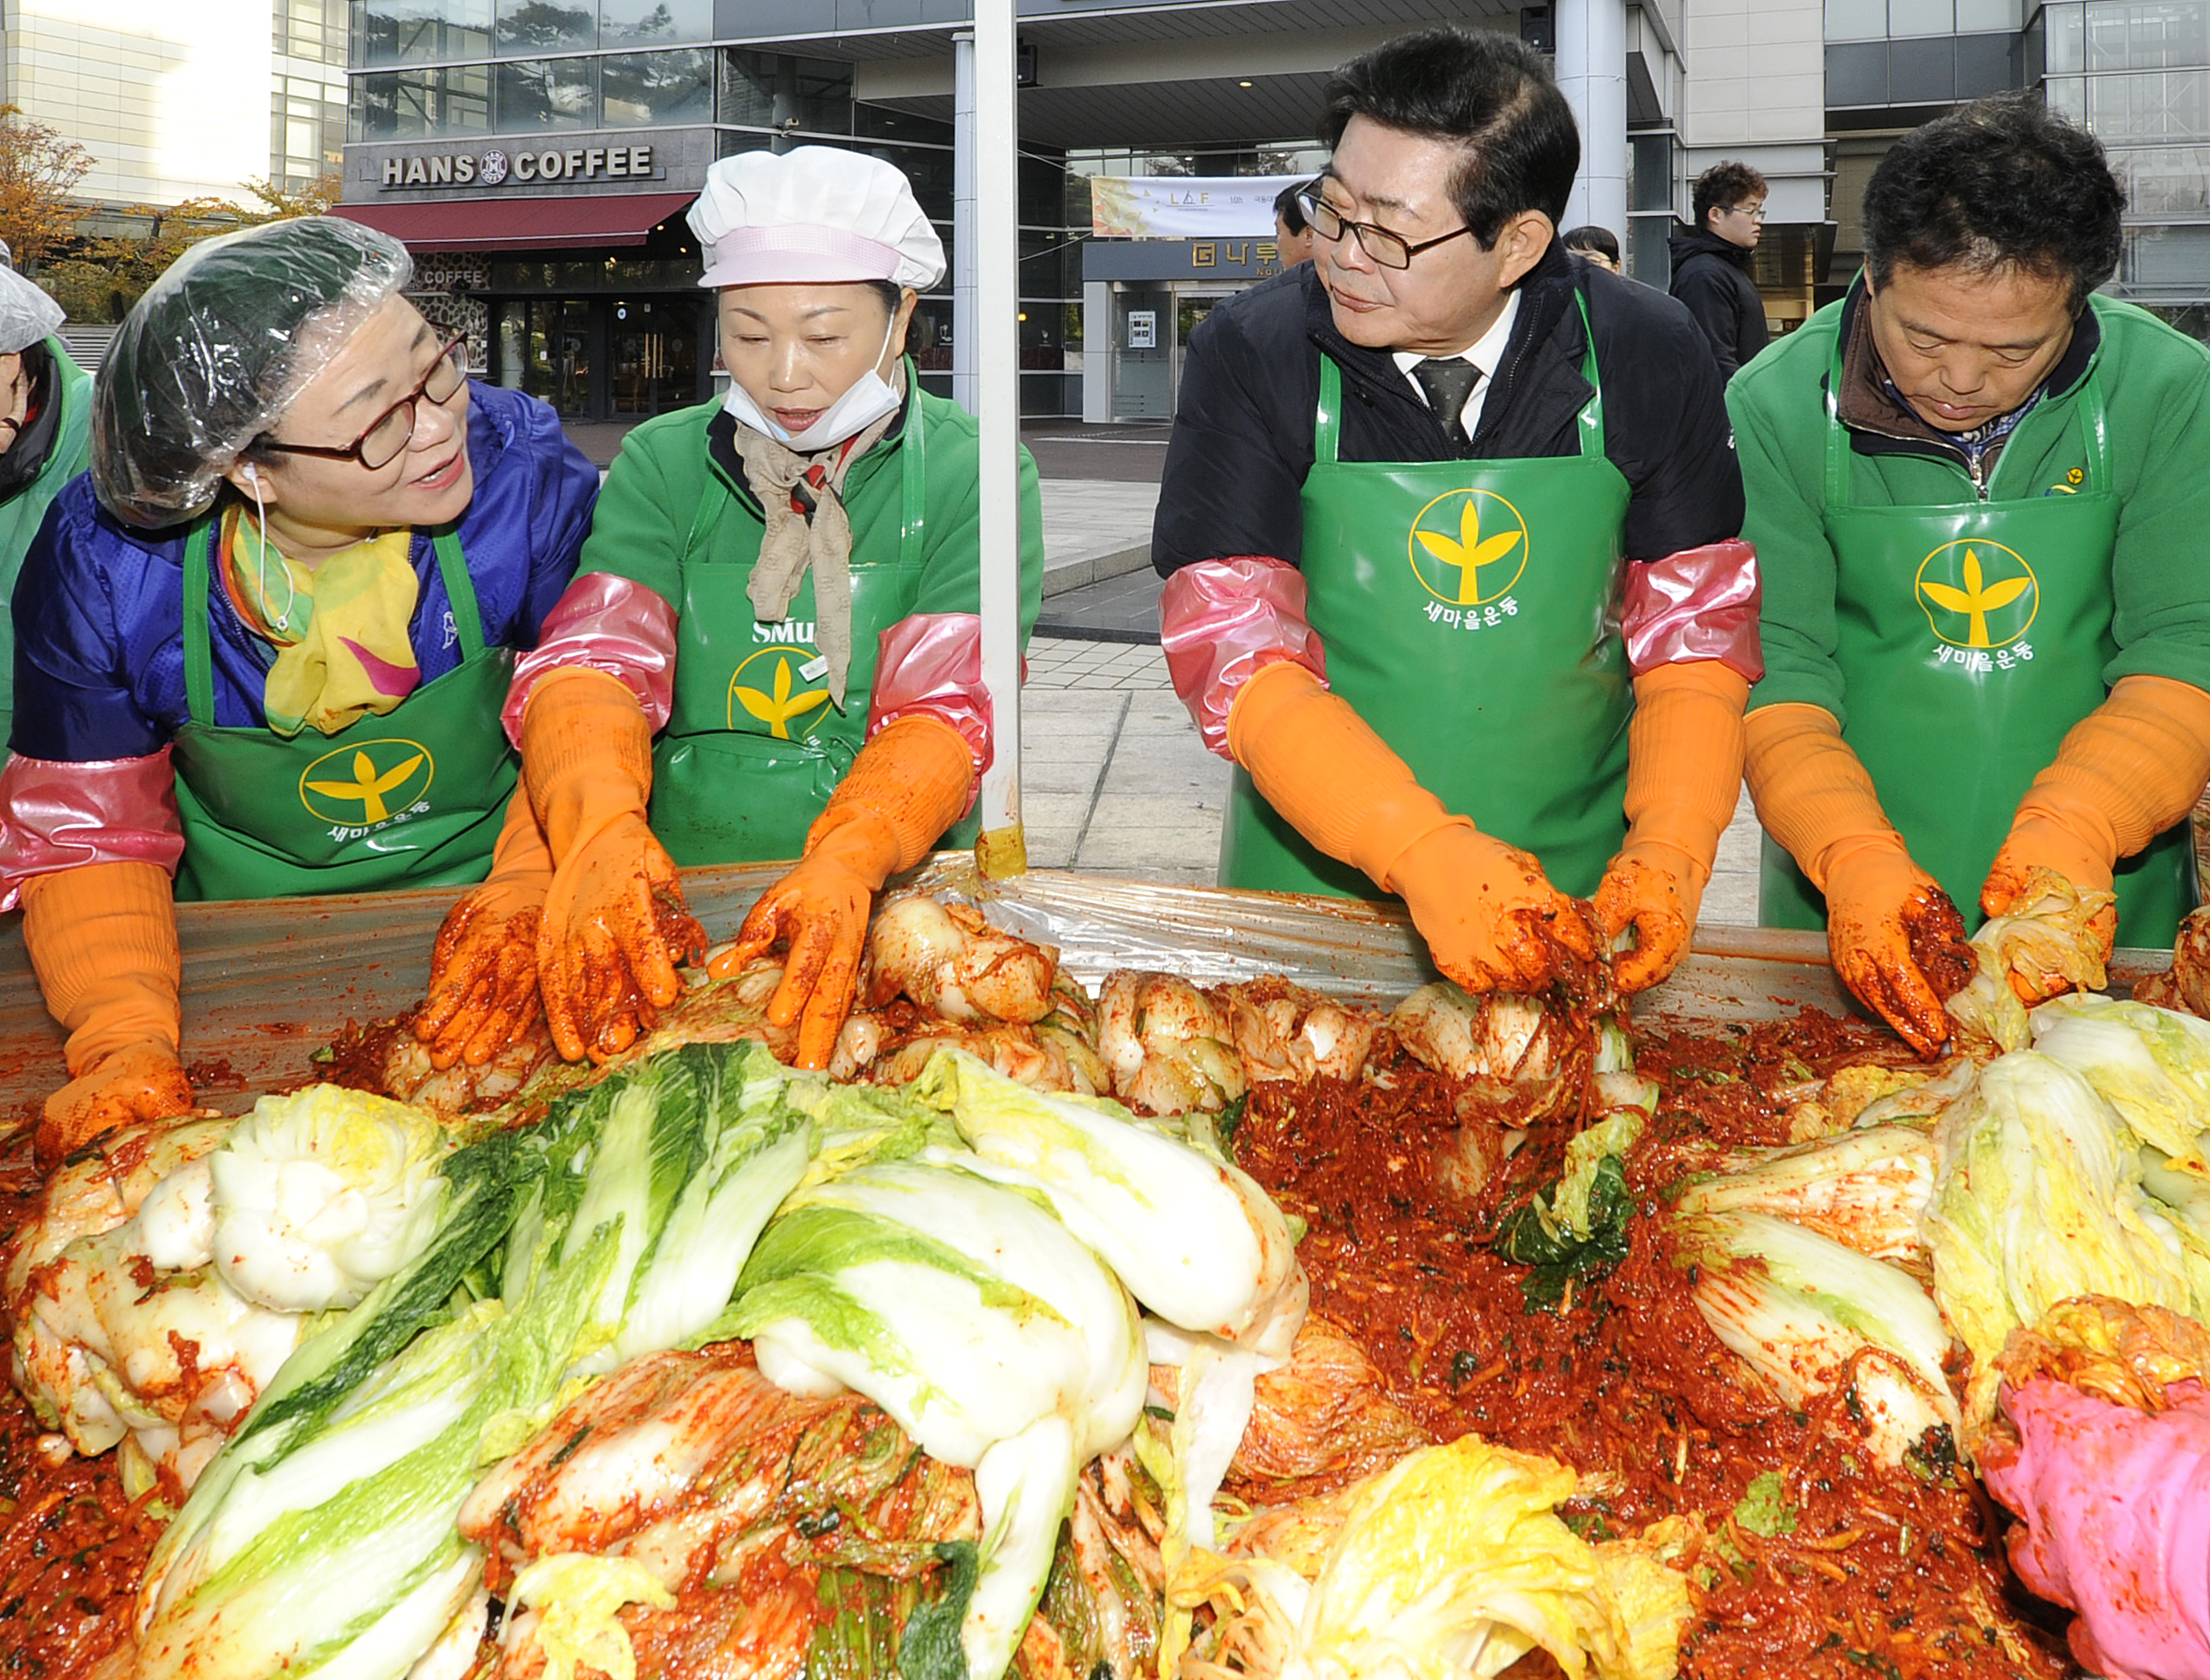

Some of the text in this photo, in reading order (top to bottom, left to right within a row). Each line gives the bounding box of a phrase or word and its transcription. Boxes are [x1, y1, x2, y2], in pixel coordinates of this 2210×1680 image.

[382, 145, 651, 185] HANS COFFEE
[424, 270, 482, 284] COFFEE
[1422, 596, 1518, 630] 새마을운동
[1932, 640, 2034, 672] 새마을운동
